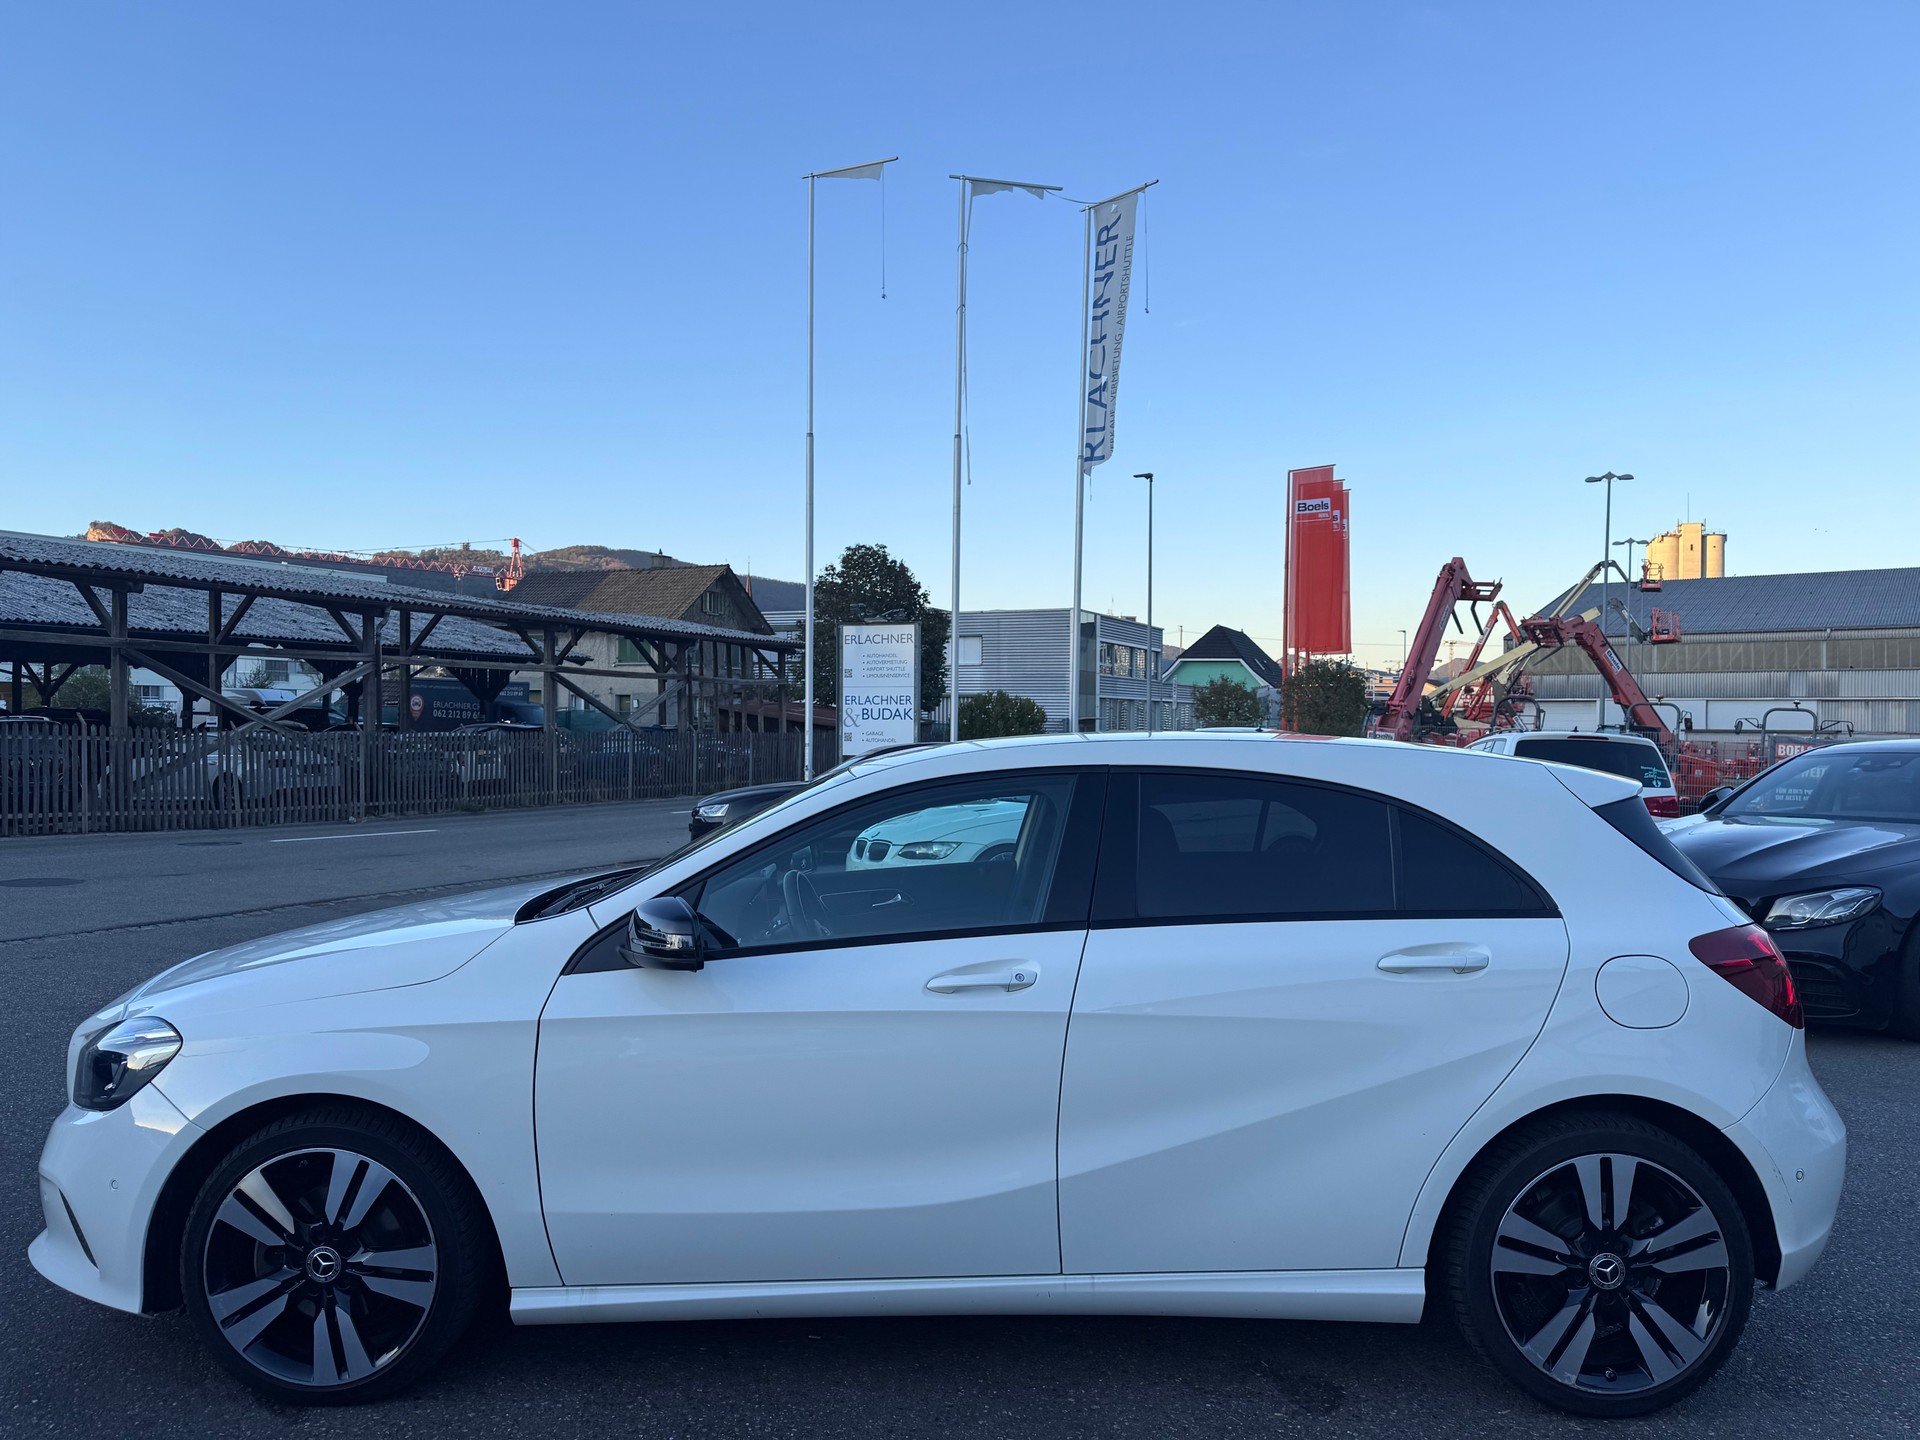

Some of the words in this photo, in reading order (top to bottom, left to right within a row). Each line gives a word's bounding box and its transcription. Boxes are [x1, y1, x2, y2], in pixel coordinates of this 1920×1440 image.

[1110, 333, 1122, 402] VERMIETUNG
[1116, 235, 1133, 325] AIRPORTSHUTTLE
[1084, 213, 1122, 462] RLACHNER
[1297, 501, 1329, 512] Boels
[844, 633, 914, 645] ERLACHNER
[844, 695, 912, 705] ERLACHNER
[432, 709, 446, 718] 062
[448, 710, 460, 718] 212
[462, 710, 471, 719] 89
[843, 707, 861, 728] &
[861, 708, 913, 720] BUDAK
